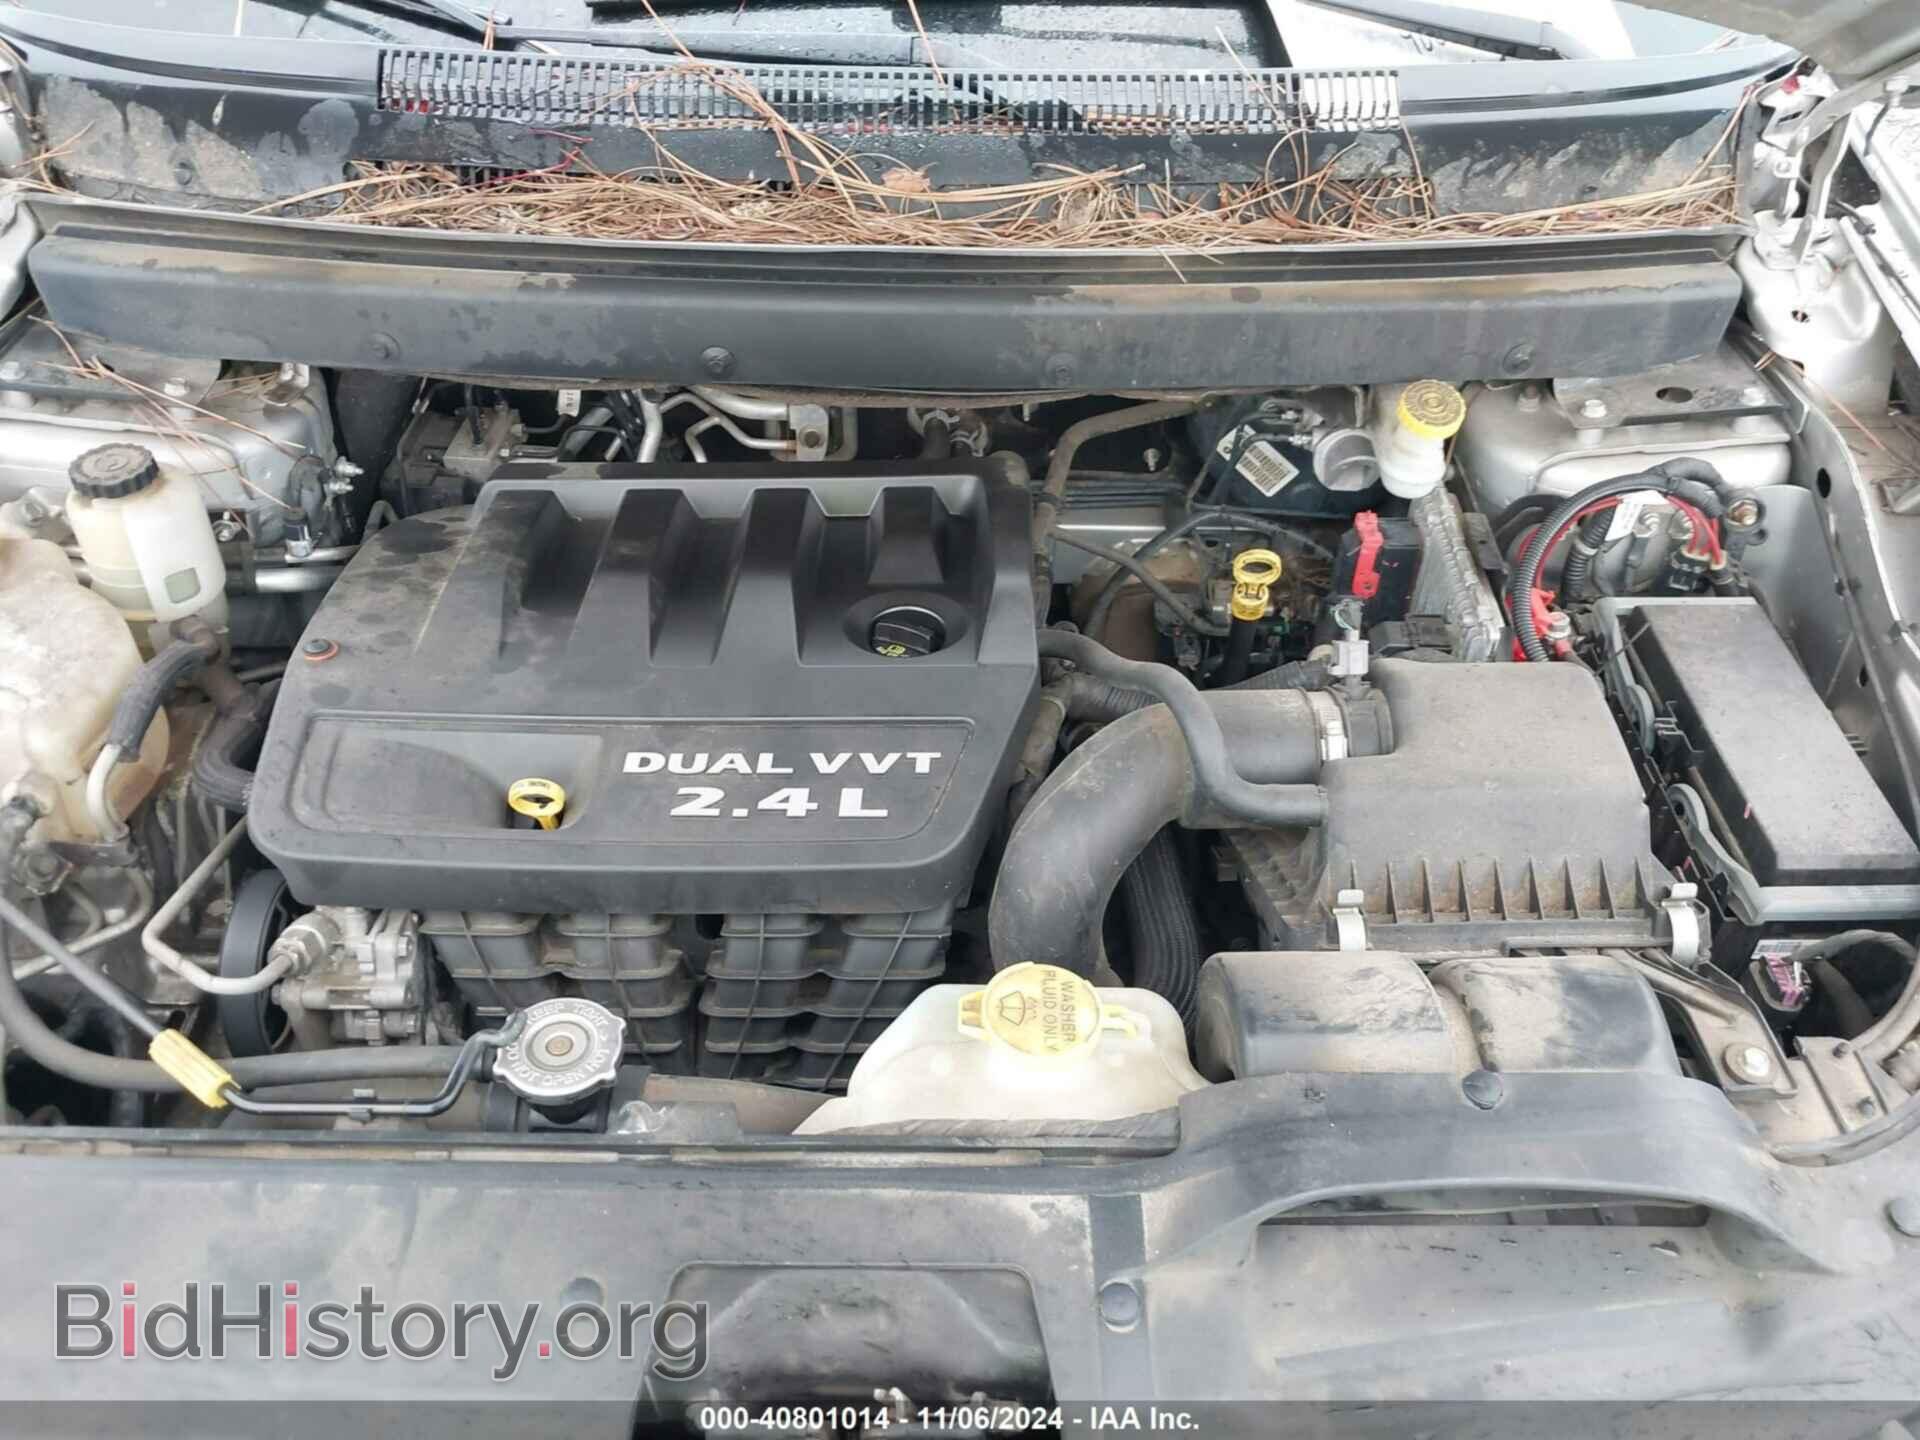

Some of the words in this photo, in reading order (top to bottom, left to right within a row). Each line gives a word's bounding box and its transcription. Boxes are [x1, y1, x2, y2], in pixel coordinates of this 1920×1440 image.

[622, 752, 794, 775] DUAL
[809, 752, 942, 774] VVT
[1040, 969, 1057, 1010] FLUID
[1060, 979, 1077, 1042] WASHER
[1042, 1014, 1060, 1052] ONLY
